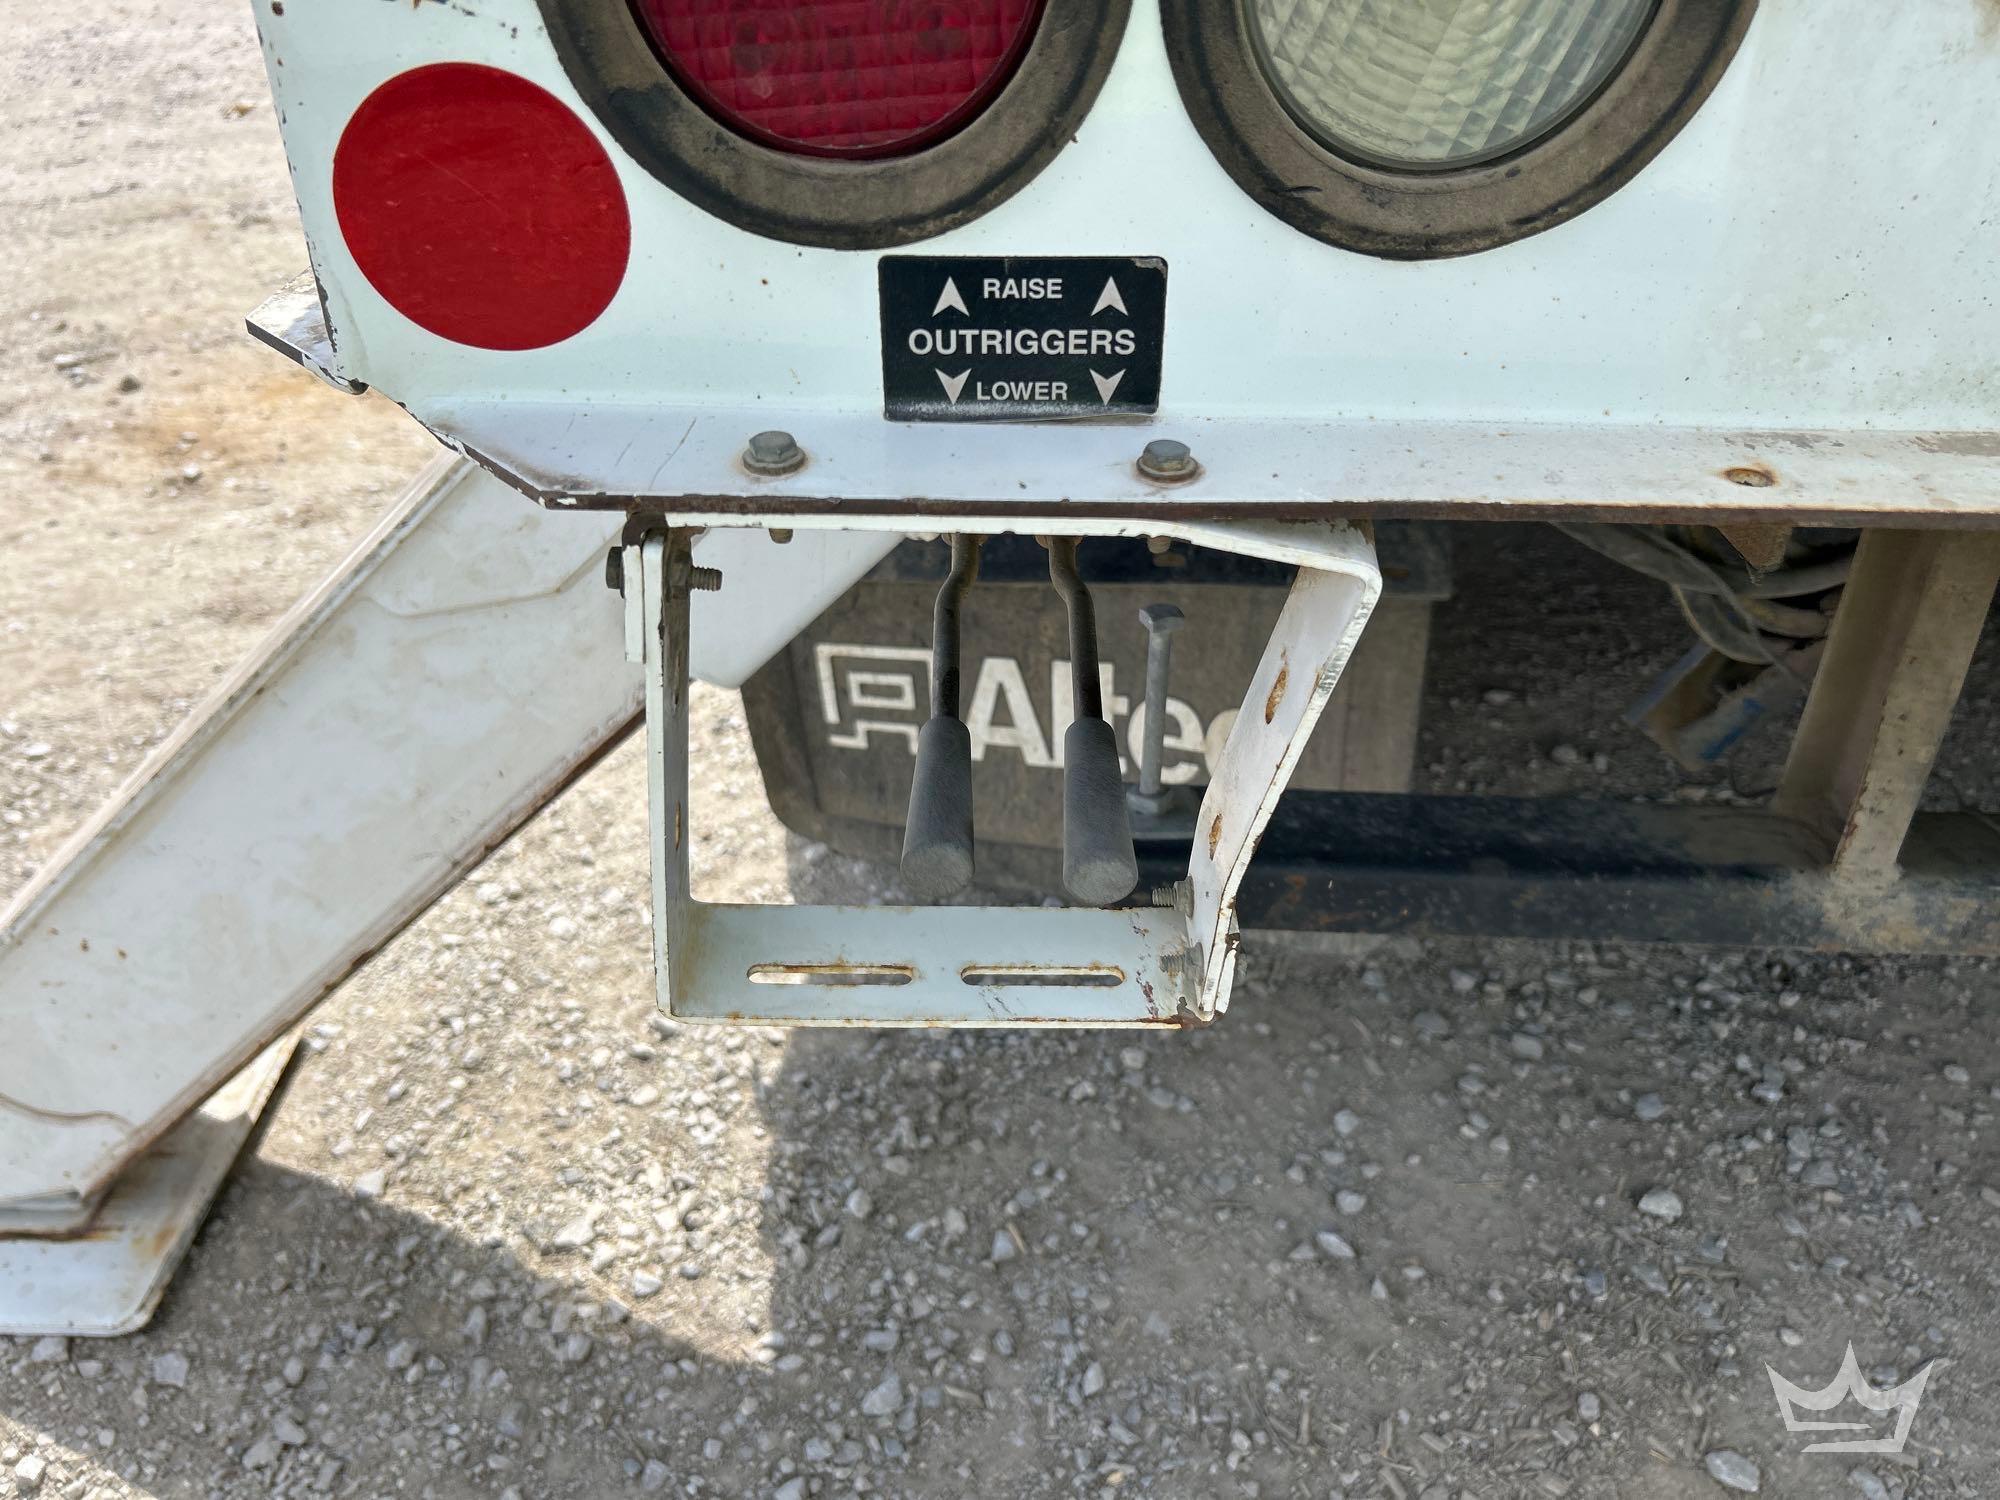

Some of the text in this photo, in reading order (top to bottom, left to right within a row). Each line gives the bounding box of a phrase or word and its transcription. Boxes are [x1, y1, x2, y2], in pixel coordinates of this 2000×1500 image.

[983, 278, 1063, 299] RAISE
[908, 328, 1136, 356] OUTRIGGERS
[976, 381, 1068, 401] LOWER
